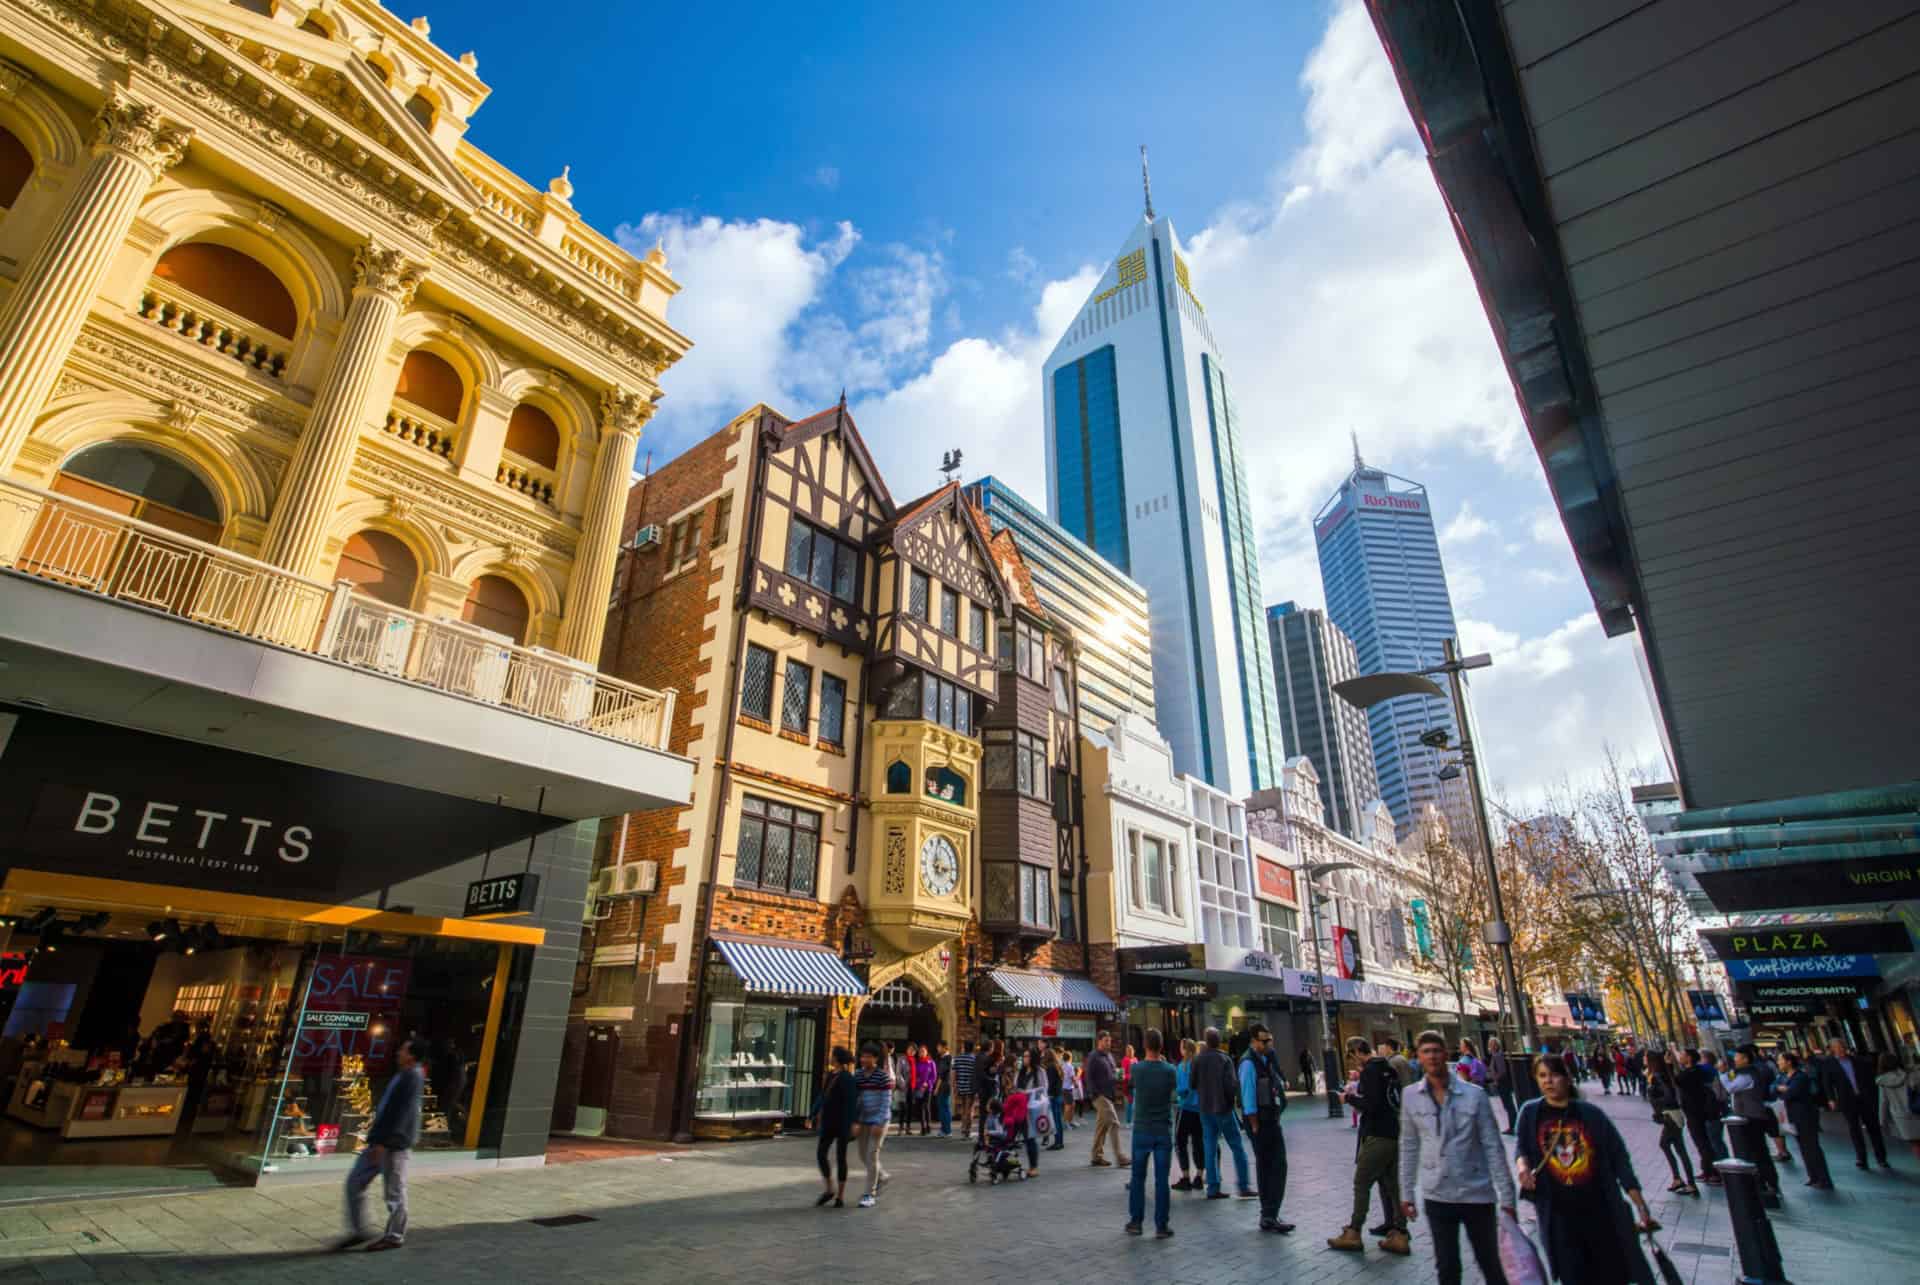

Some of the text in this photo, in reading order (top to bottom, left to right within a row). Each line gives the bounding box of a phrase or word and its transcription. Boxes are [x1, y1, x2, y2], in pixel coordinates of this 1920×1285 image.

[73, 791, 313, 863] BETTS
[127, 848, 195, 866] AUSTRALIA
[1849, 870, 1912, 885] VIRGIN
[468, 879, 517, 905] BETTS
[1732, 932, 1828, 952] PLAZA
[311, 964, 403, 999] SALE
[1175, 983, 1207, 997] city chic
[306, 1013, 366, 1024] SALE CONTINUES
